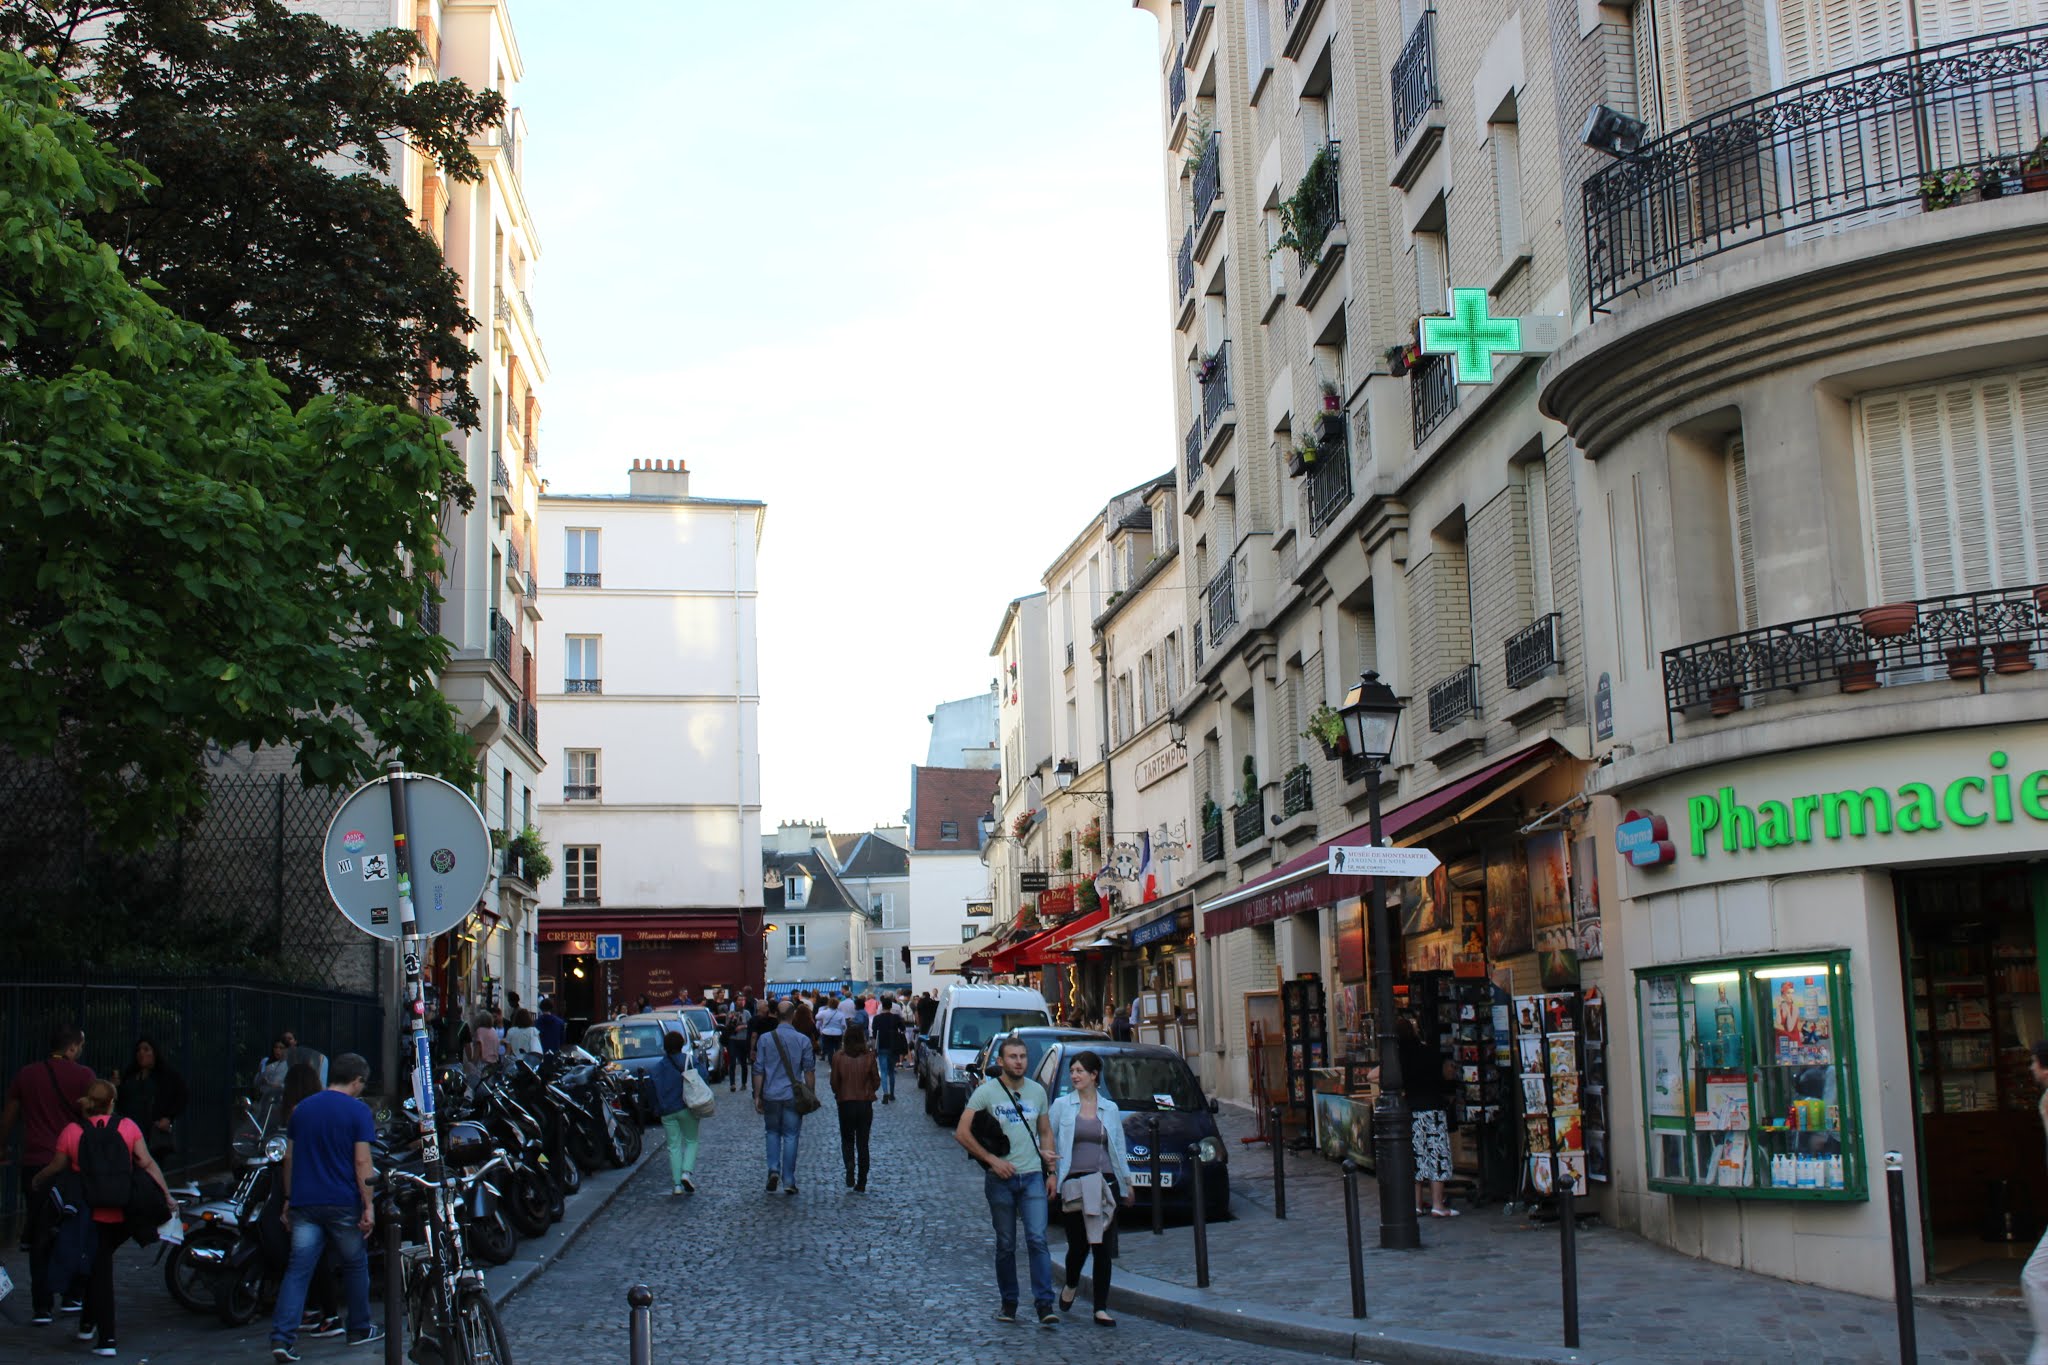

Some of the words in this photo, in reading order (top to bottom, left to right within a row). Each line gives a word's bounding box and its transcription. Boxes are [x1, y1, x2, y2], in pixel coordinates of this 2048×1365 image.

[1143, 747, 1185, 783] TARTEMPIO
[1687, 751, 2048, 857] Pharmacie
[1382, 852, 1427, 860] MONTMARTRE
